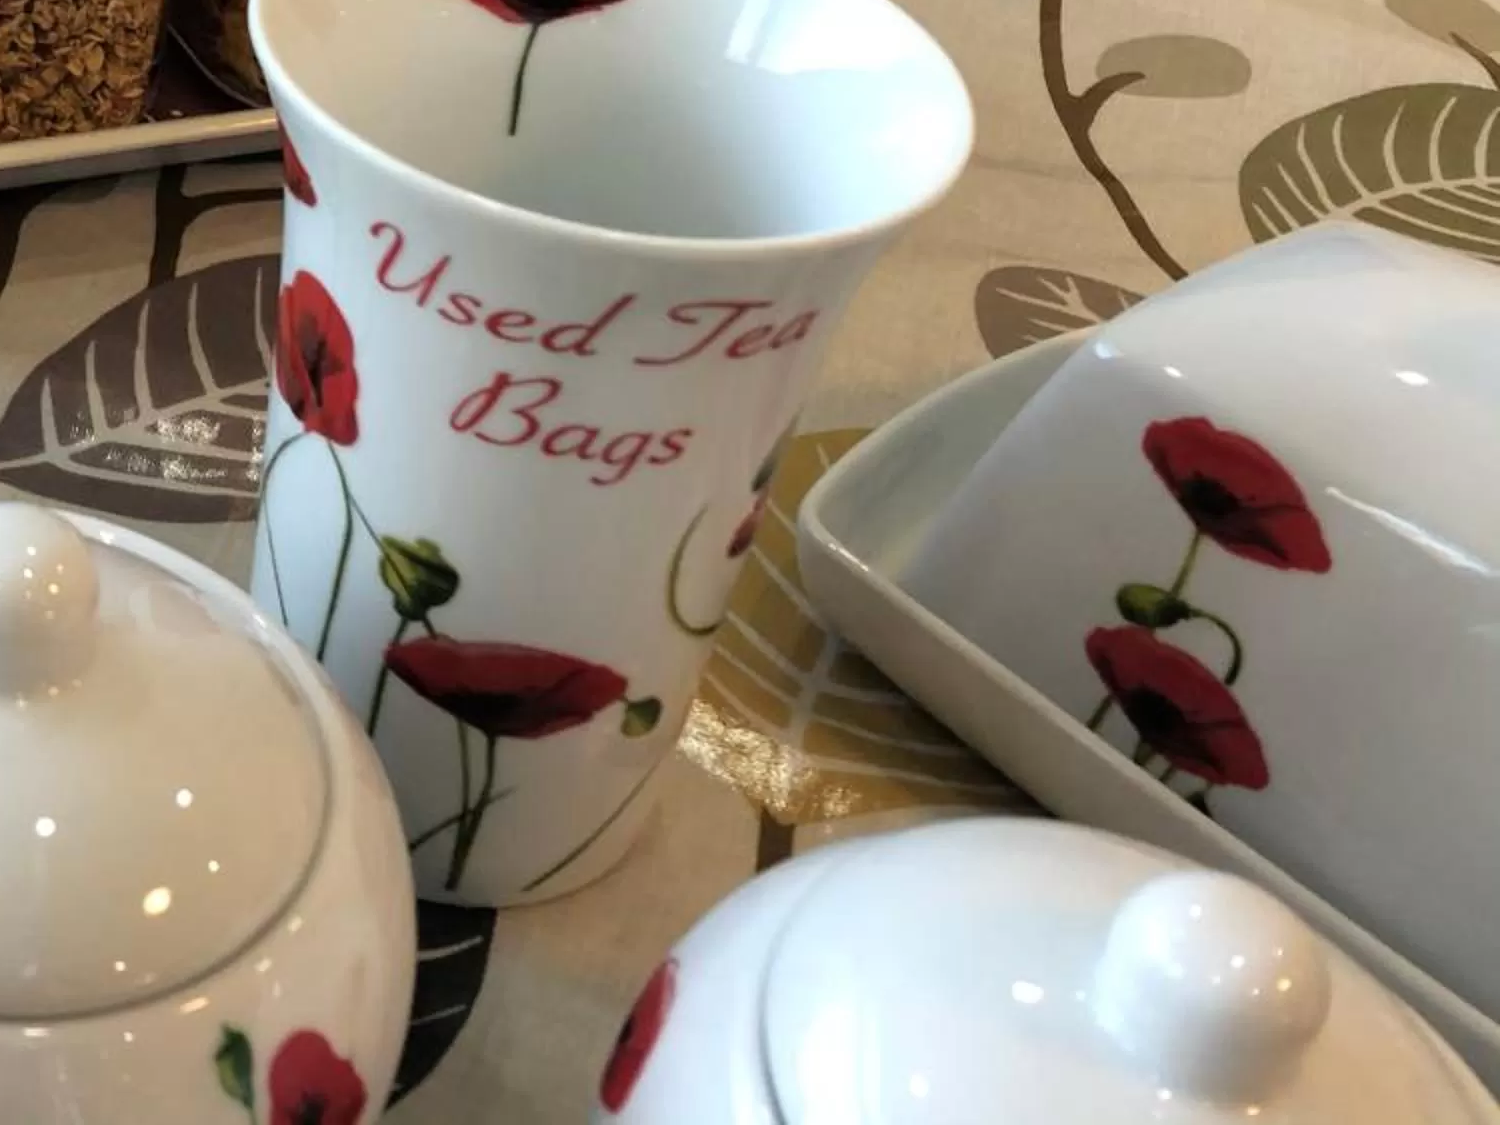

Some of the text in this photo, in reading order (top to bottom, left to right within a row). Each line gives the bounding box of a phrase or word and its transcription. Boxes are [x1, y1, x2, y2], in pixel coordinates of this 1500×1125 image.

[369, 221, 821, 366] Used Tea
[449, 373, 695, 486] Bags
